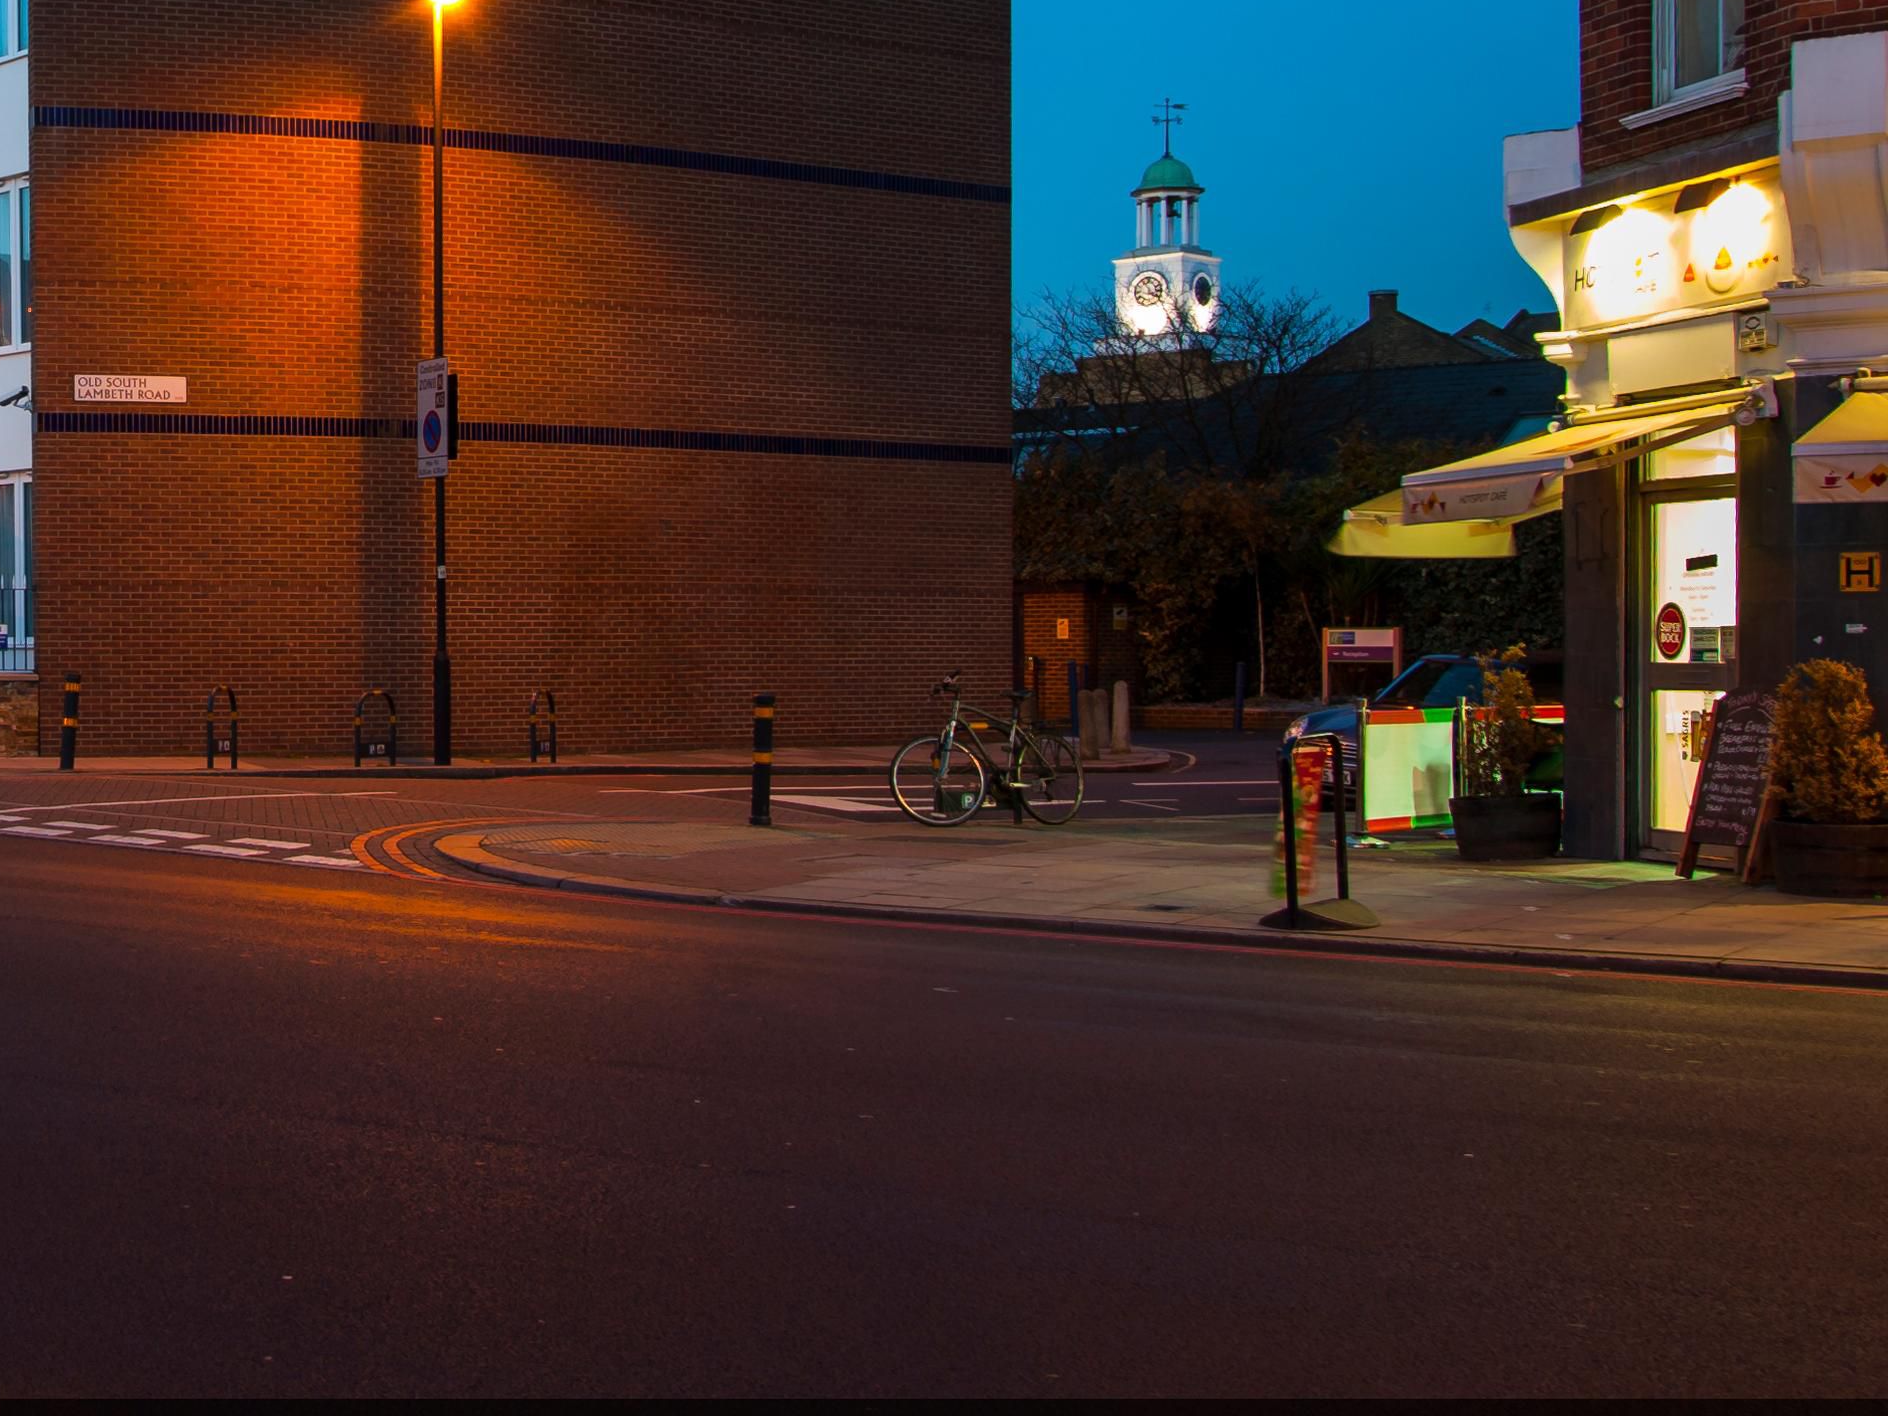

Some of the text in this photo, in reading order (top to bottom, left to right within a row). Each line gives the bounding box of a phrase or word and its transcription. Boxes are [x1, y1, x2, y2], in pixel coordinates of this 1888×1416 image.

[78, 377, 147, 388] OLD SOUTH
[77, 388, 171, 400] LAMBETH ROAD
[1660, 622, 1682, 632] SUPER
[1661, 632, 1680, 643] BOCK
